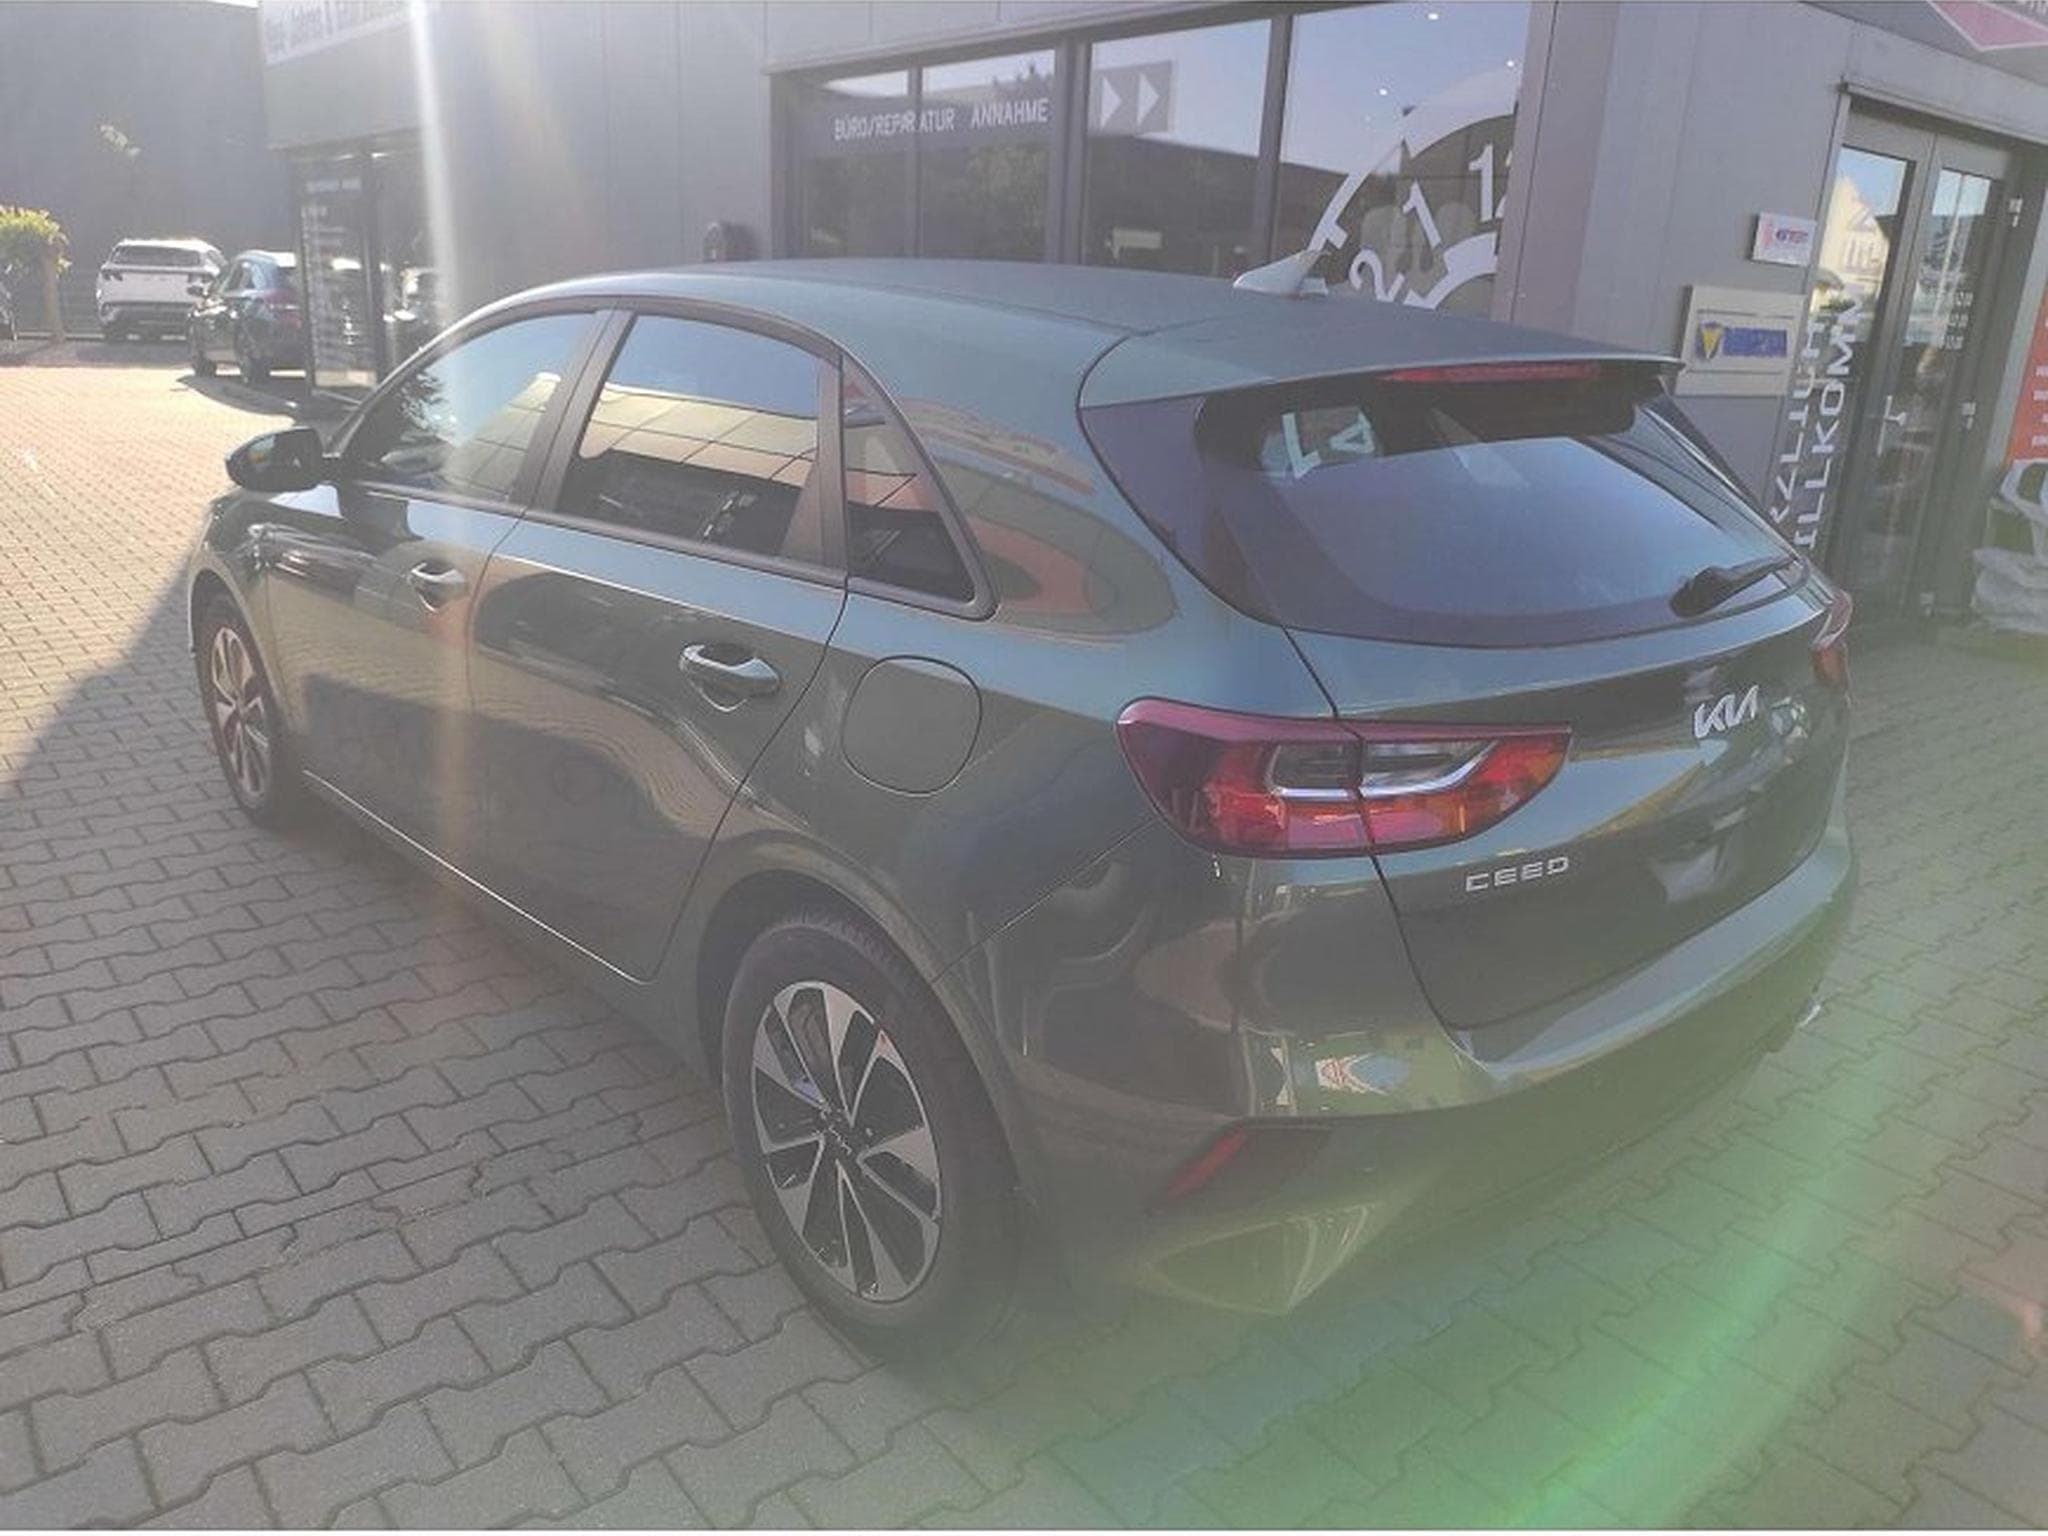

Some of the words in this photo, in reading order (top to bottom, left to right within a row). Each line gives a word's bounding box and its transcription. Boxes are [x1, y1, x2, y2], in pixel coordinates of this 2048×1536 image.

[971, 98, 1049, 128] ANNAHME
[1694, 685, 1758, 738] KIA
[1466, 857, 1569, 892] CEED
